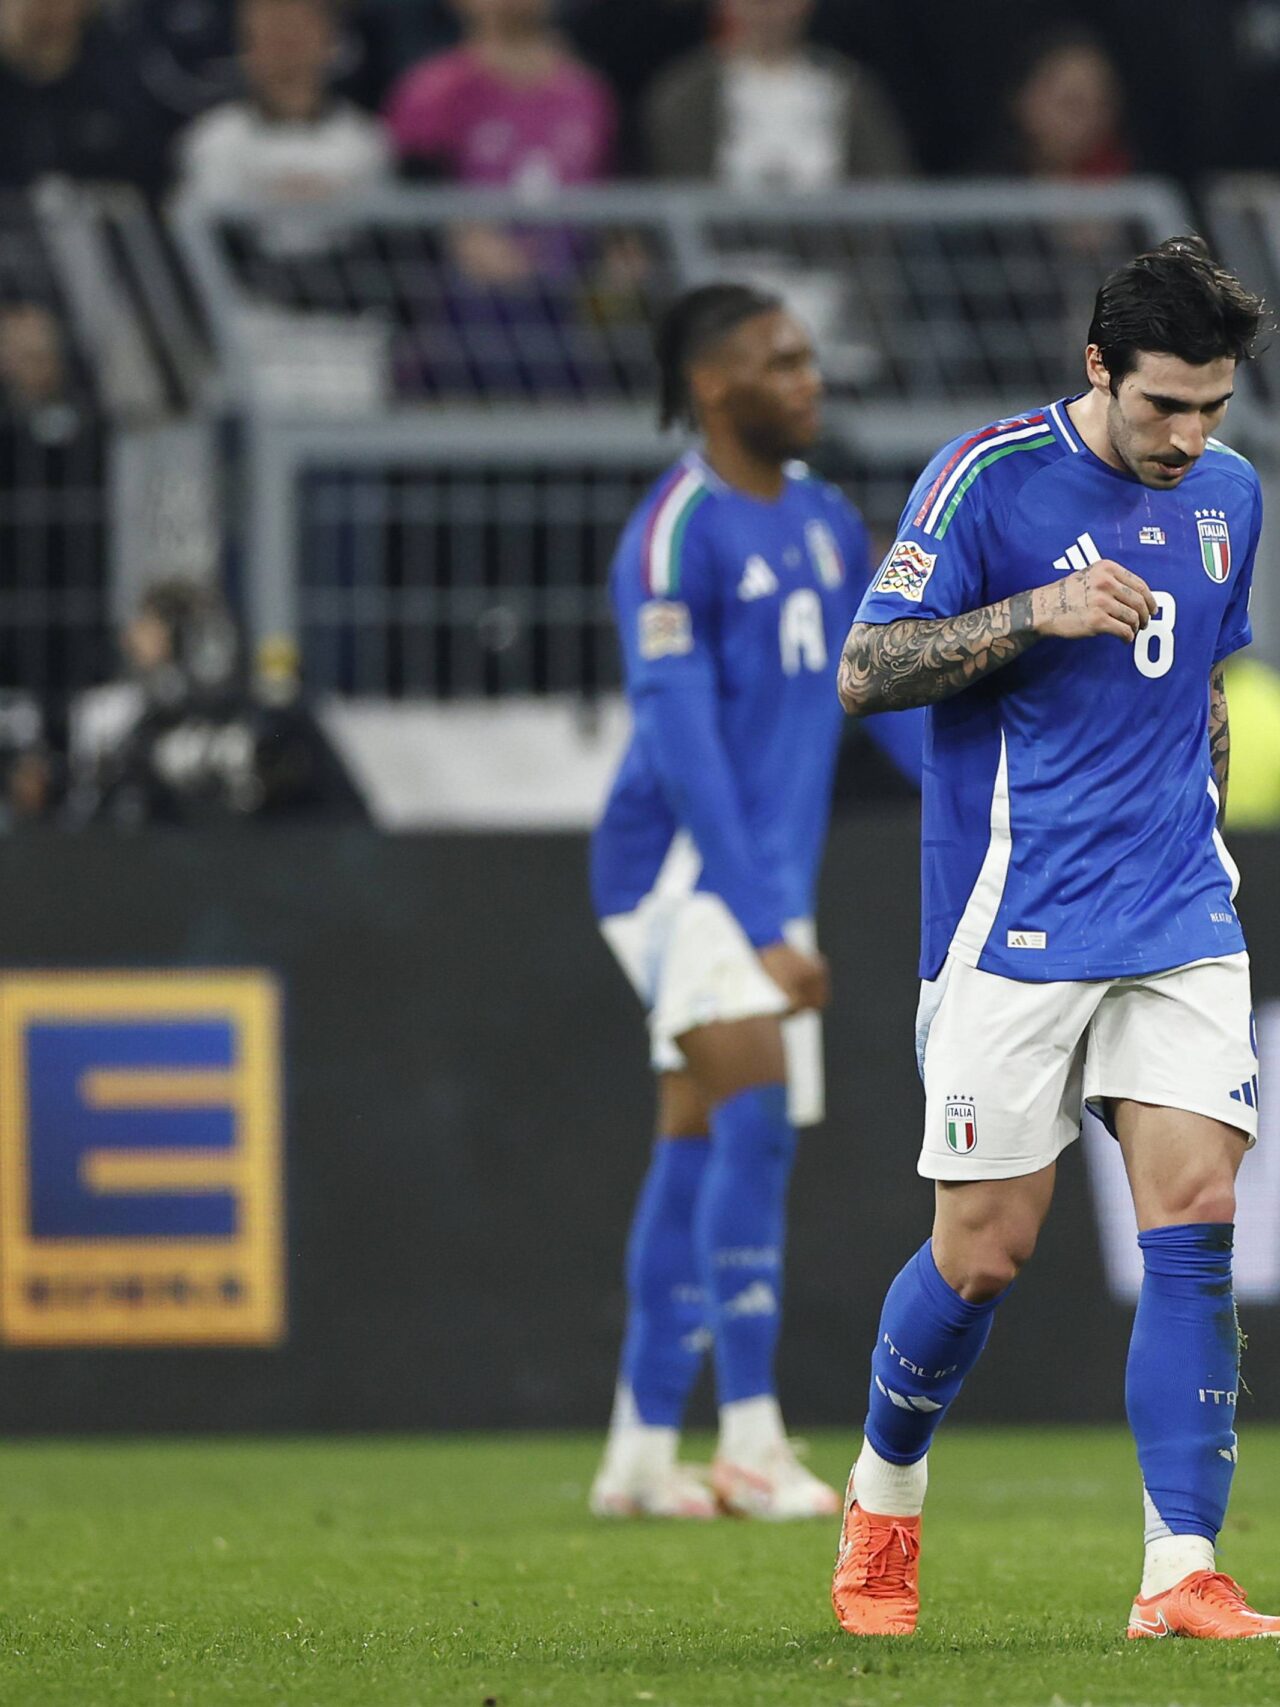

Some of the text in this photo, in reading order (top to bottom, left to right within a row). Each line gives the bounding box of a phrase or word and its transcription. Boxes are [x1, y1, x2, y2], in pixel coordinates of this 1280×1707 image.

[1200, 524, 1225, 537] ITALIA
[1134, 591, 1176, 679] 8
[25, 1018, 238, 1240] E
[947, 1107, 972, 1117] ITALIA
[883, 1332, 957, 1378] ITALIA
